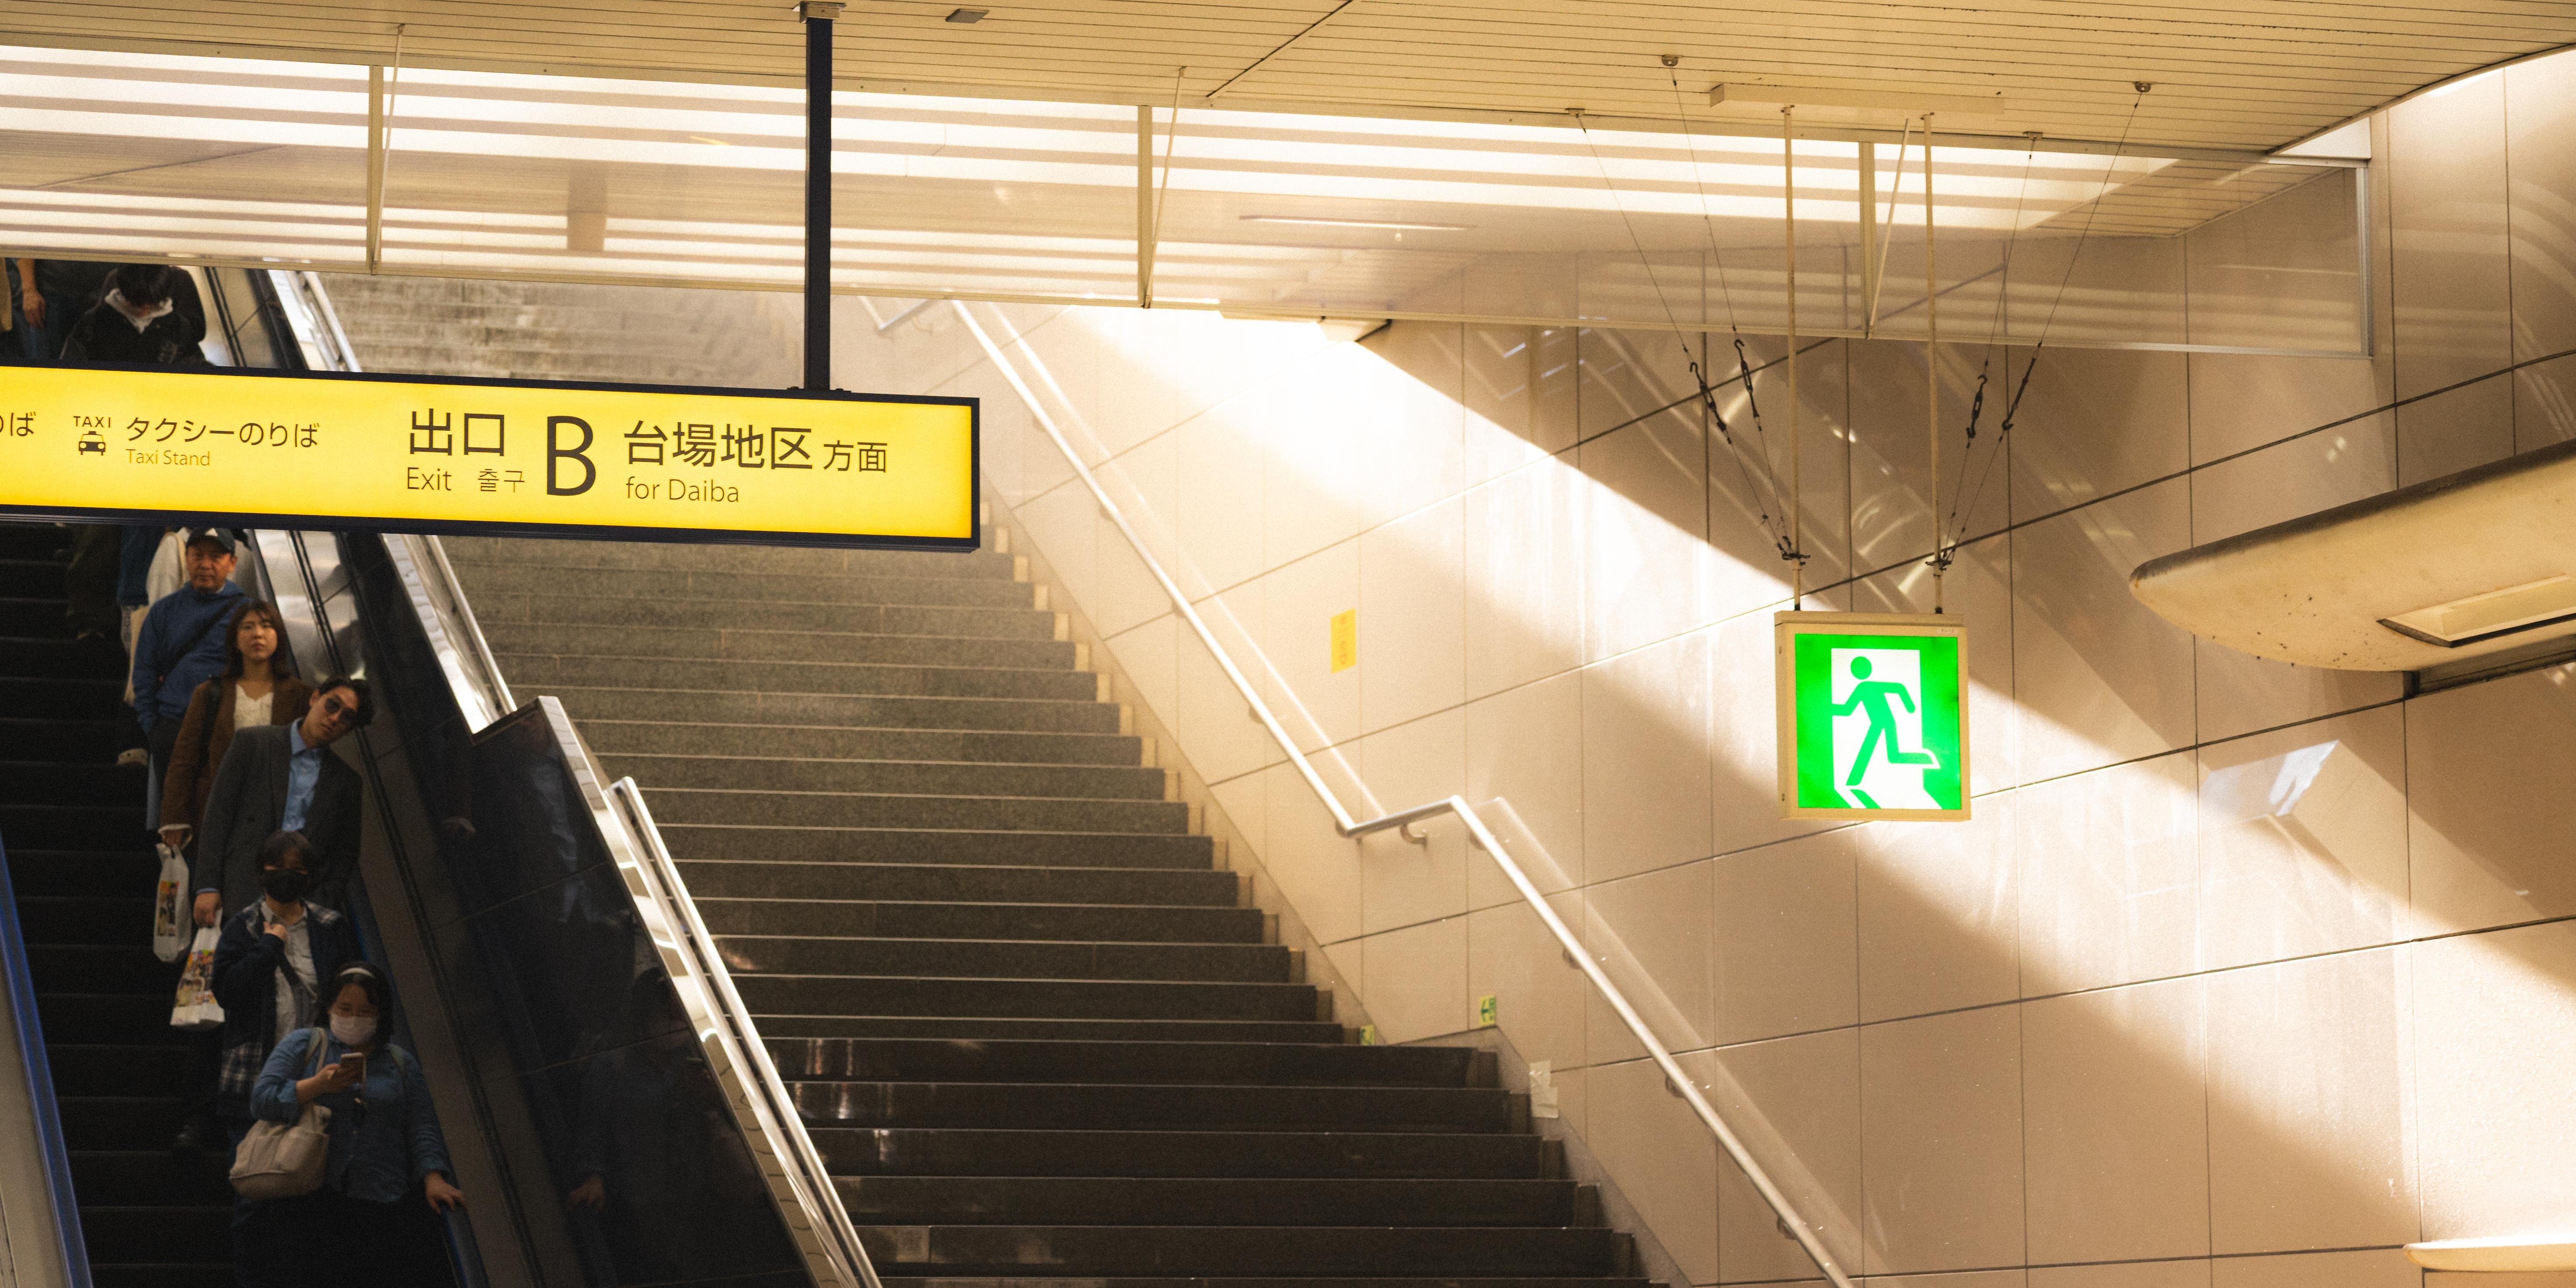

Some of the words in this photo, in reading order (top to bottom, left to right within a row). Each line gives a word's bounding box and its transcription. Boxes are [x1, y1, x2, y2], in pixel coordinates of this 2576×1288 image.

[0, 411, 36, 437] ば
[73, 416, 111, 428] TAXI
[126, 417, 319, 448] タクシーのりば
[125, 448, 158, 465] Taxi
[163, 450, 210, 466] Stand
[409, 408, 505, 457] 出口
[546, 415, 597, 496] B
[407, 466, 452, 491] Exit
[477, 468, 525, 493] 출구
[626, 476, 661, 500] for
[668, 479, 739, 503] Daiba
